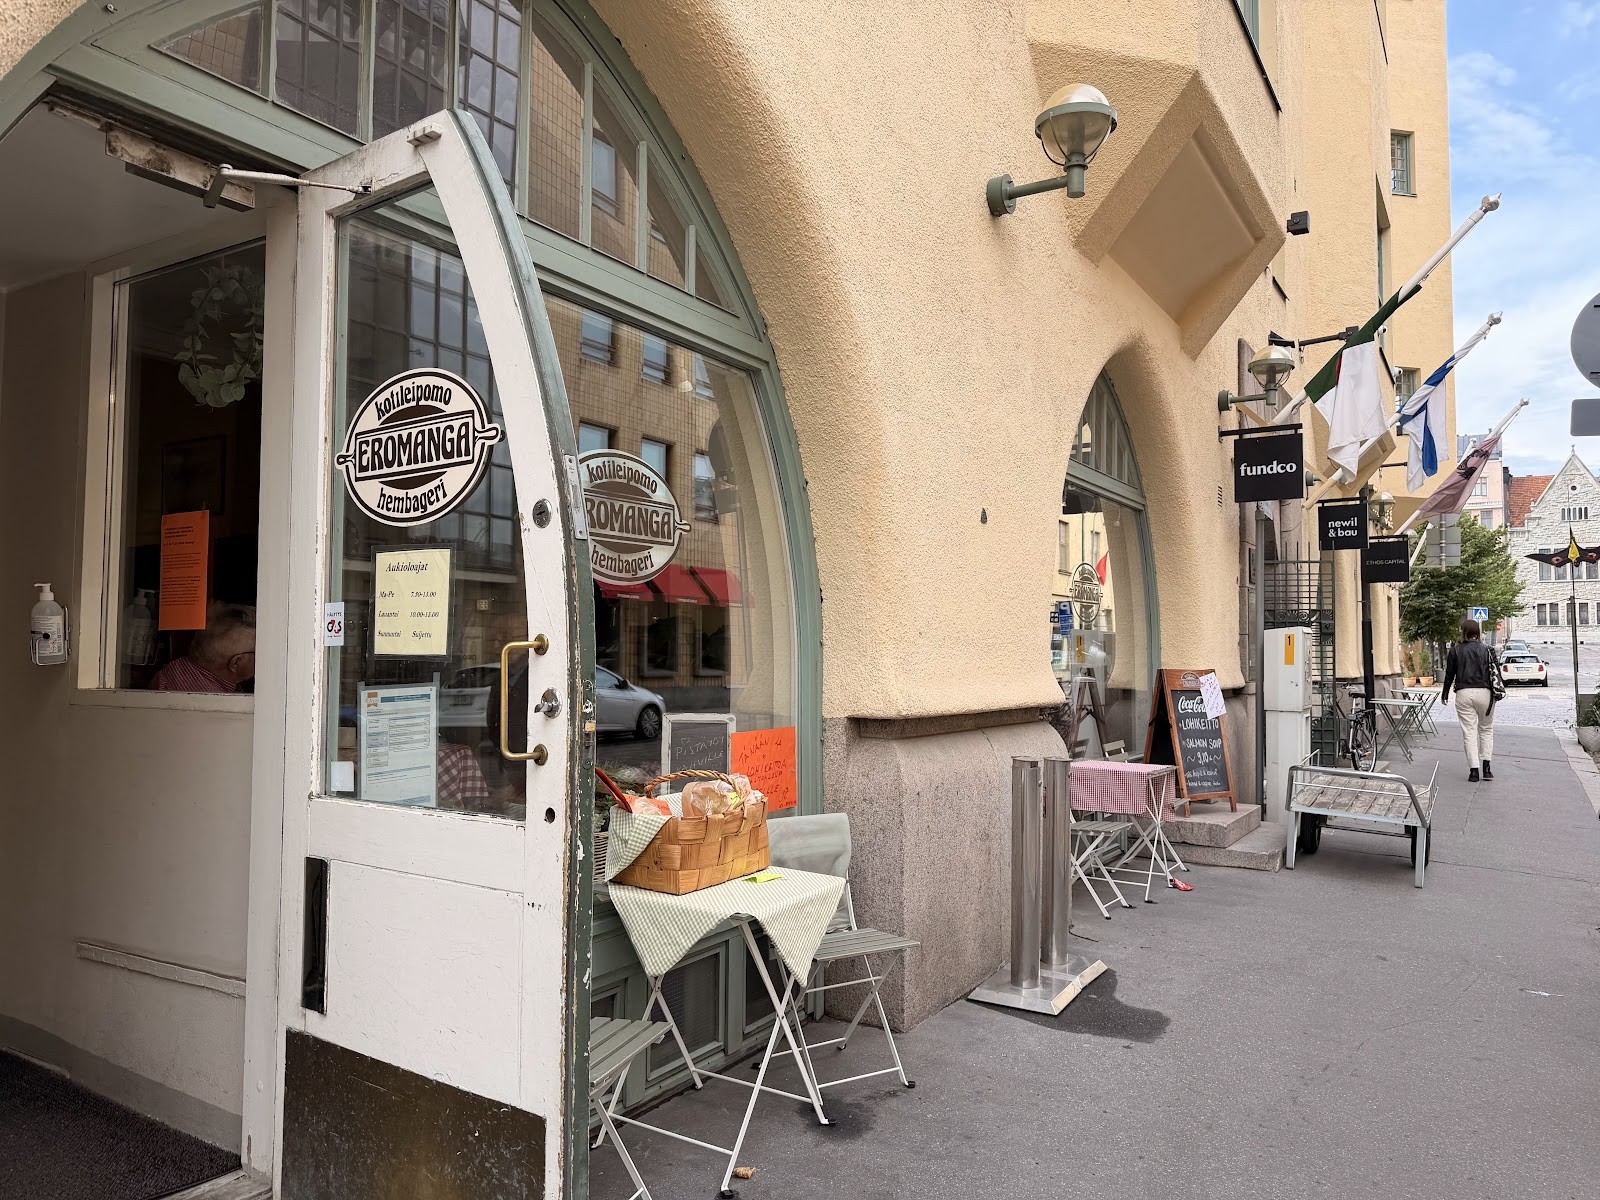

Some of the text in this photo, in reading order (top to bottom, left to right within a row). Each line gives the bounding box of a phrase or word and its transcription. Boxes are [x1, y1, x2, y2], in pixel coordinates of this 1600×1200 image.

[374, 381, 452, 421] kotileipomo
[357, 421, 471, 474] EROMANGA
[586, 460, 658, 494] kotileipomo
[1239, 460, 1297, 477] fundco
[376, 478, 448, 514] hembageri
[585, 497, 672, 540] ROMANGA
[1328, 516, 1358, 528] newil
[1328, 527, 1358, 538] & bau
[386, 561, 428, 574] Aukioloajat
[591, 544, 655, 576] hembageri
[1287, 634, 1292, 646] 1
[1208, 738, 1222, 749] SOUP
